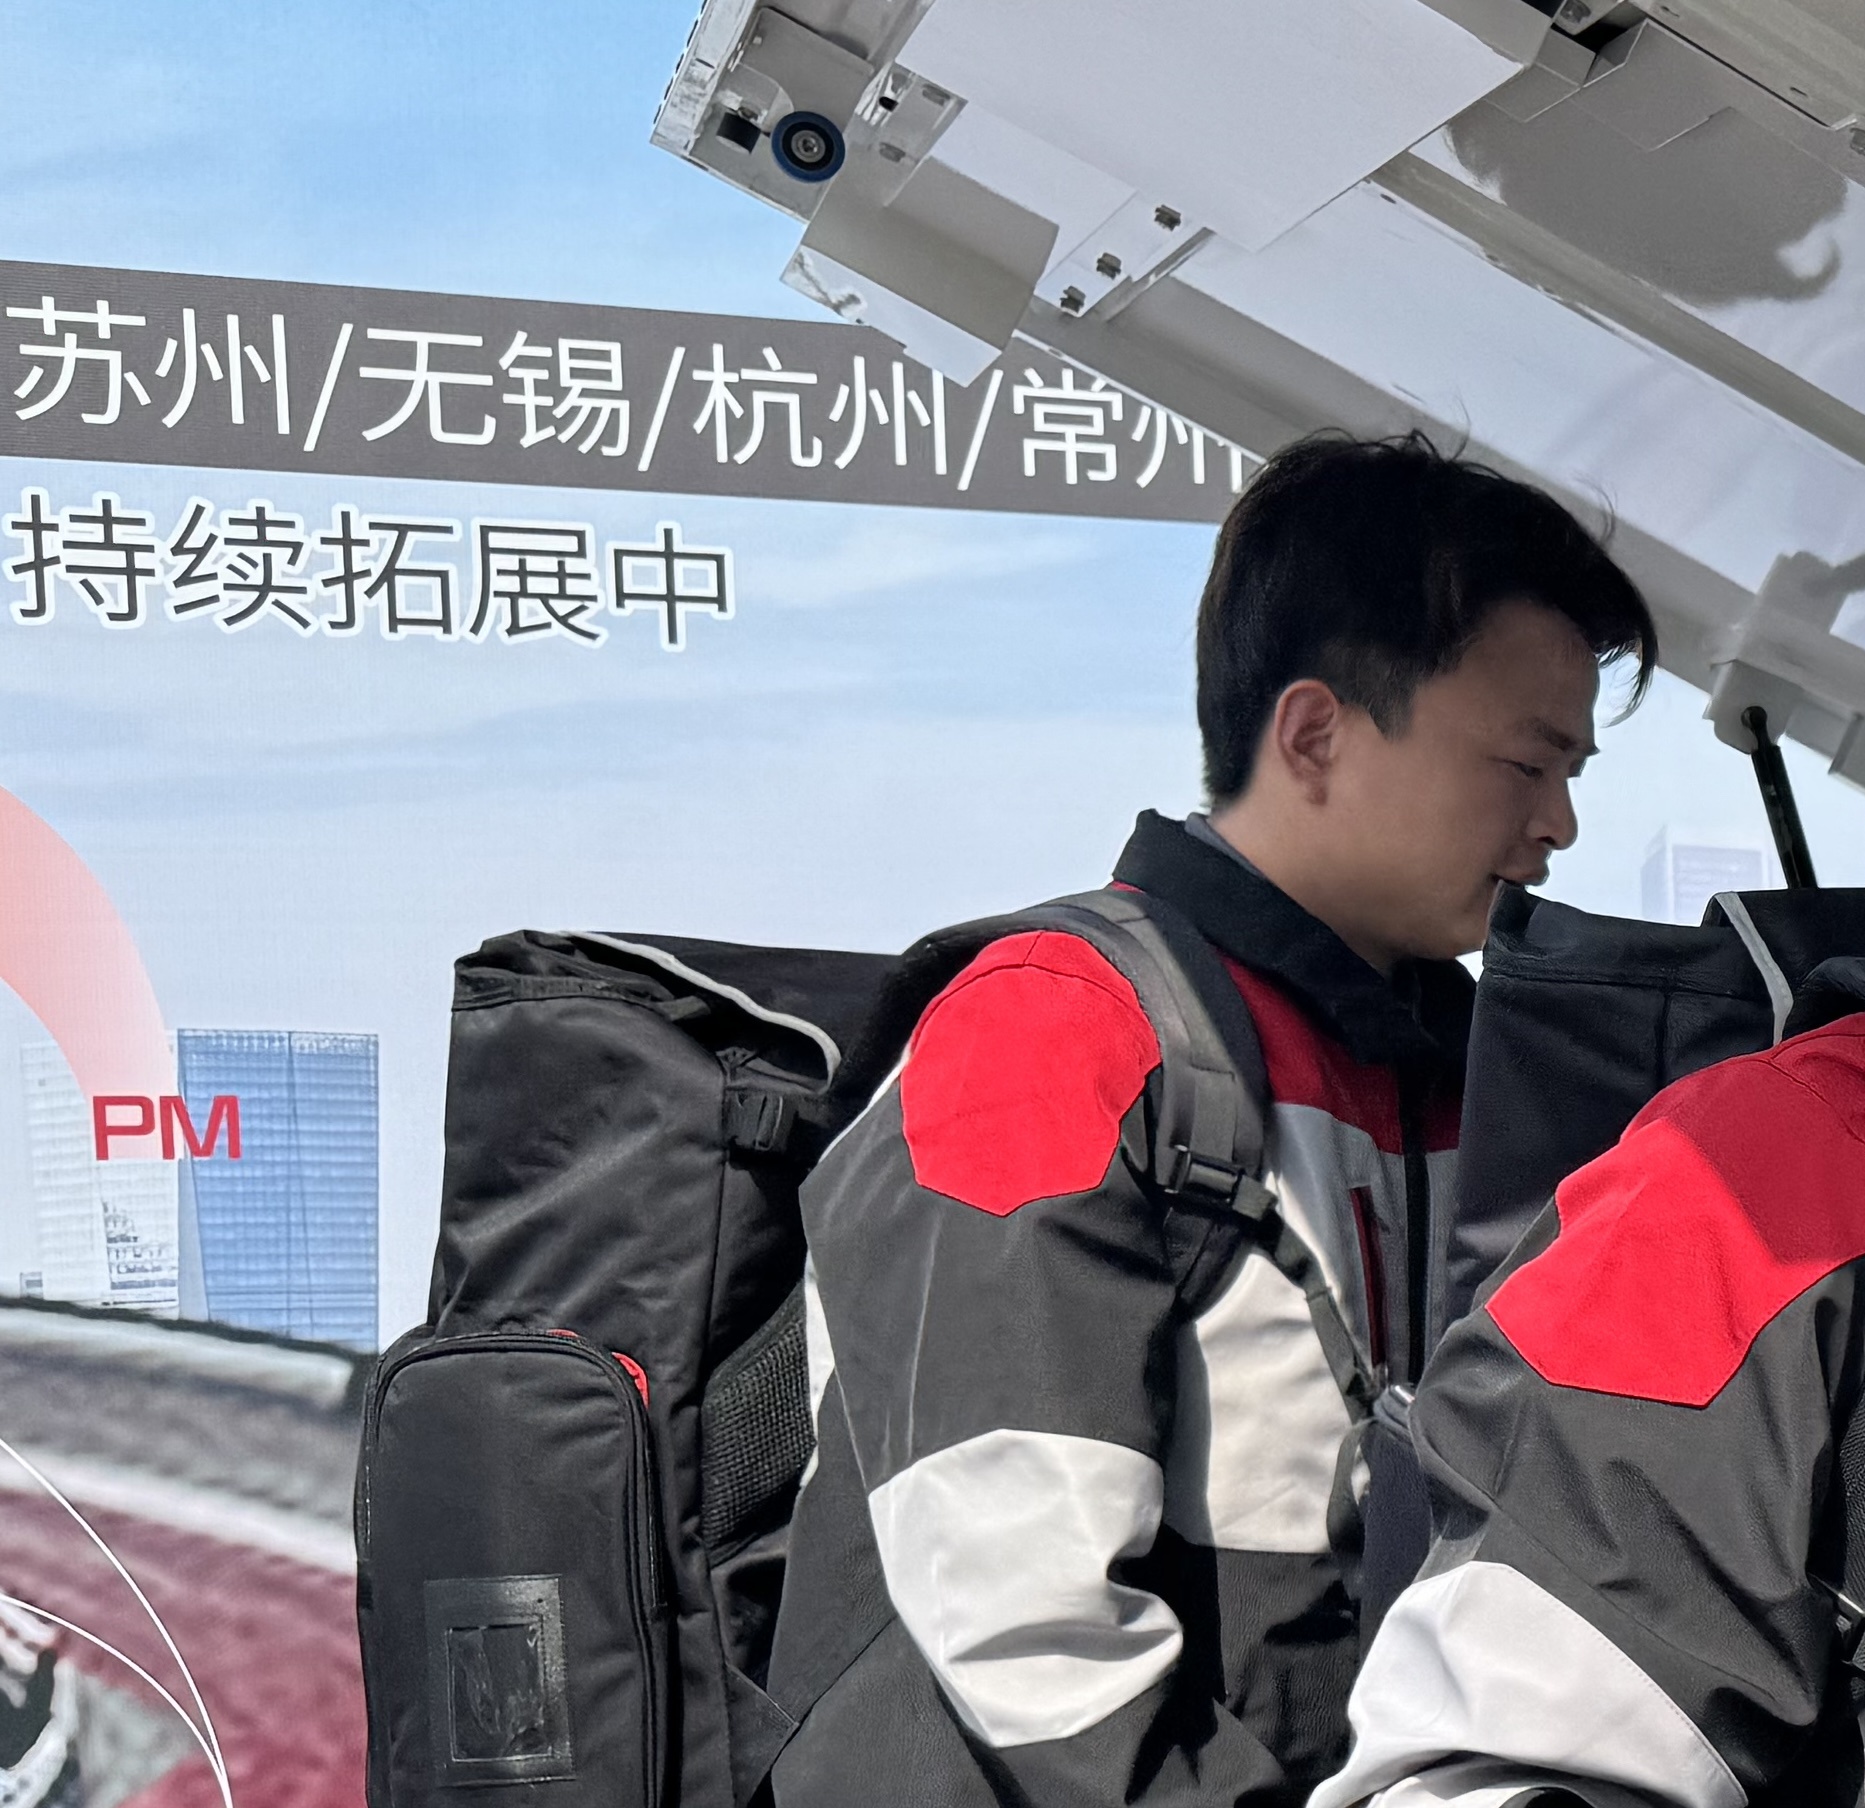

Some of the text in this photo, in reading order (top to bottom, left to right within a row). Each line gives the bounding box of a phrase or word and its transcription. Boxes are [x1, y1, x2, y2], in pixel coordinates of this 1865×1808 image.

[4, 294, 1243, 495] 苏州/无锡/杭州/常州
[7, 491, 730, 648] 持续拓展中
[93, 1095, 240, 1160] PM
